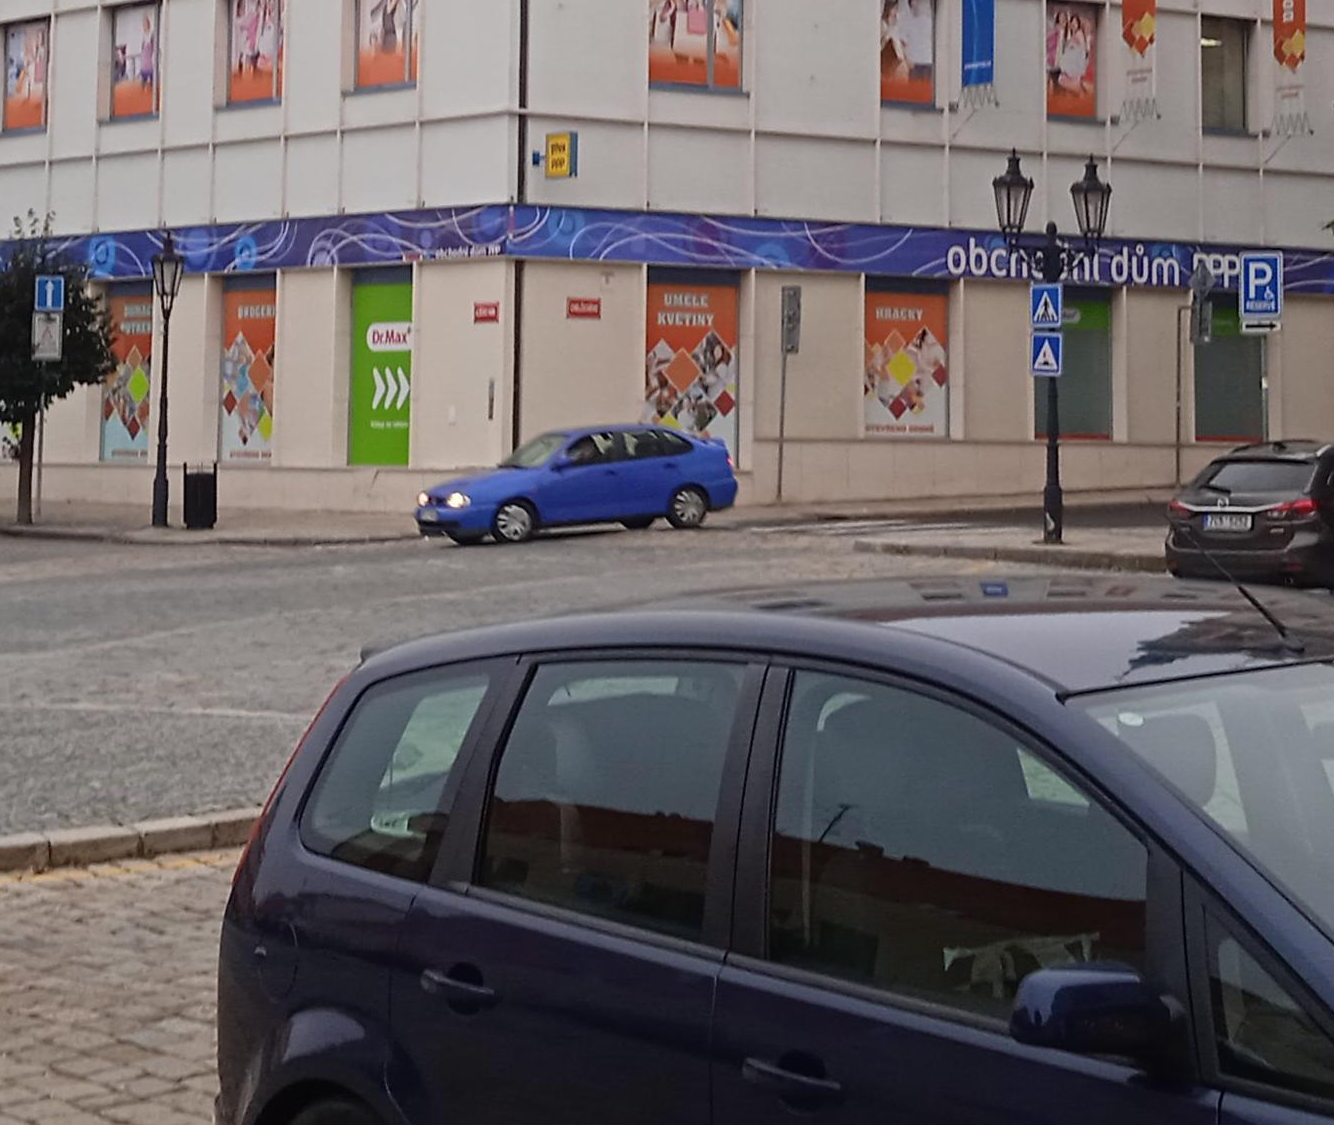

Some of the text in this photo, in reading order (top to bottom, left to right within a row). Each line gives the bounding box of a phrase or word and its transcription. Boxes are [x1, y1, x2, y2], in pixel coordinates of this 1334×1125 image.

[947, 237, 1100, 282] obchoní
[1111, 244, 1180, 285] dům
[1249, 261, 1273, 299] P
